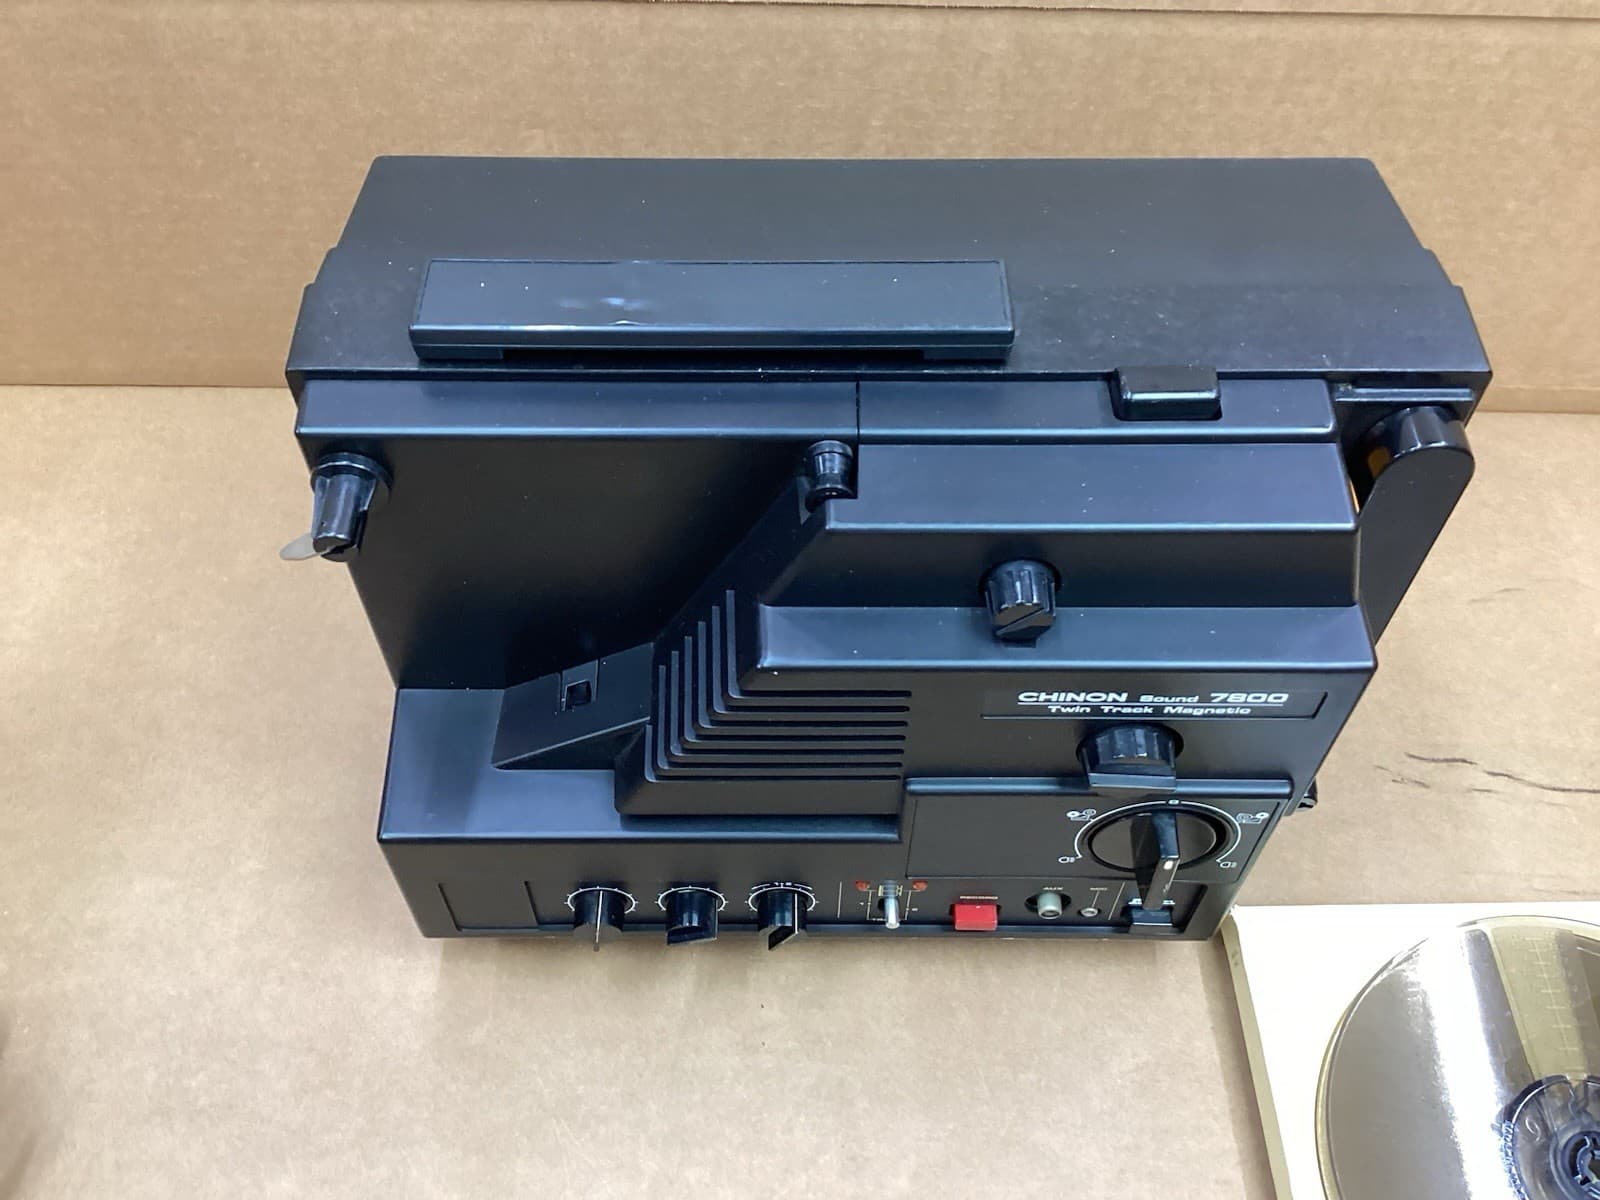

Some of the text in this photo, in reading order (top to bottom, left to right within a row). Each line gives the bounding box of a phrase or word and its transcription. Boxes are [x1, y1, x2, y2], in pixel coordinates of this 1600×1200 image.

[1018, 692, 1289, 703] CHINON Sound 7800
[1100, 706, 1154, 714] Track
[1163, 706, 1252, 716] Magnetic
